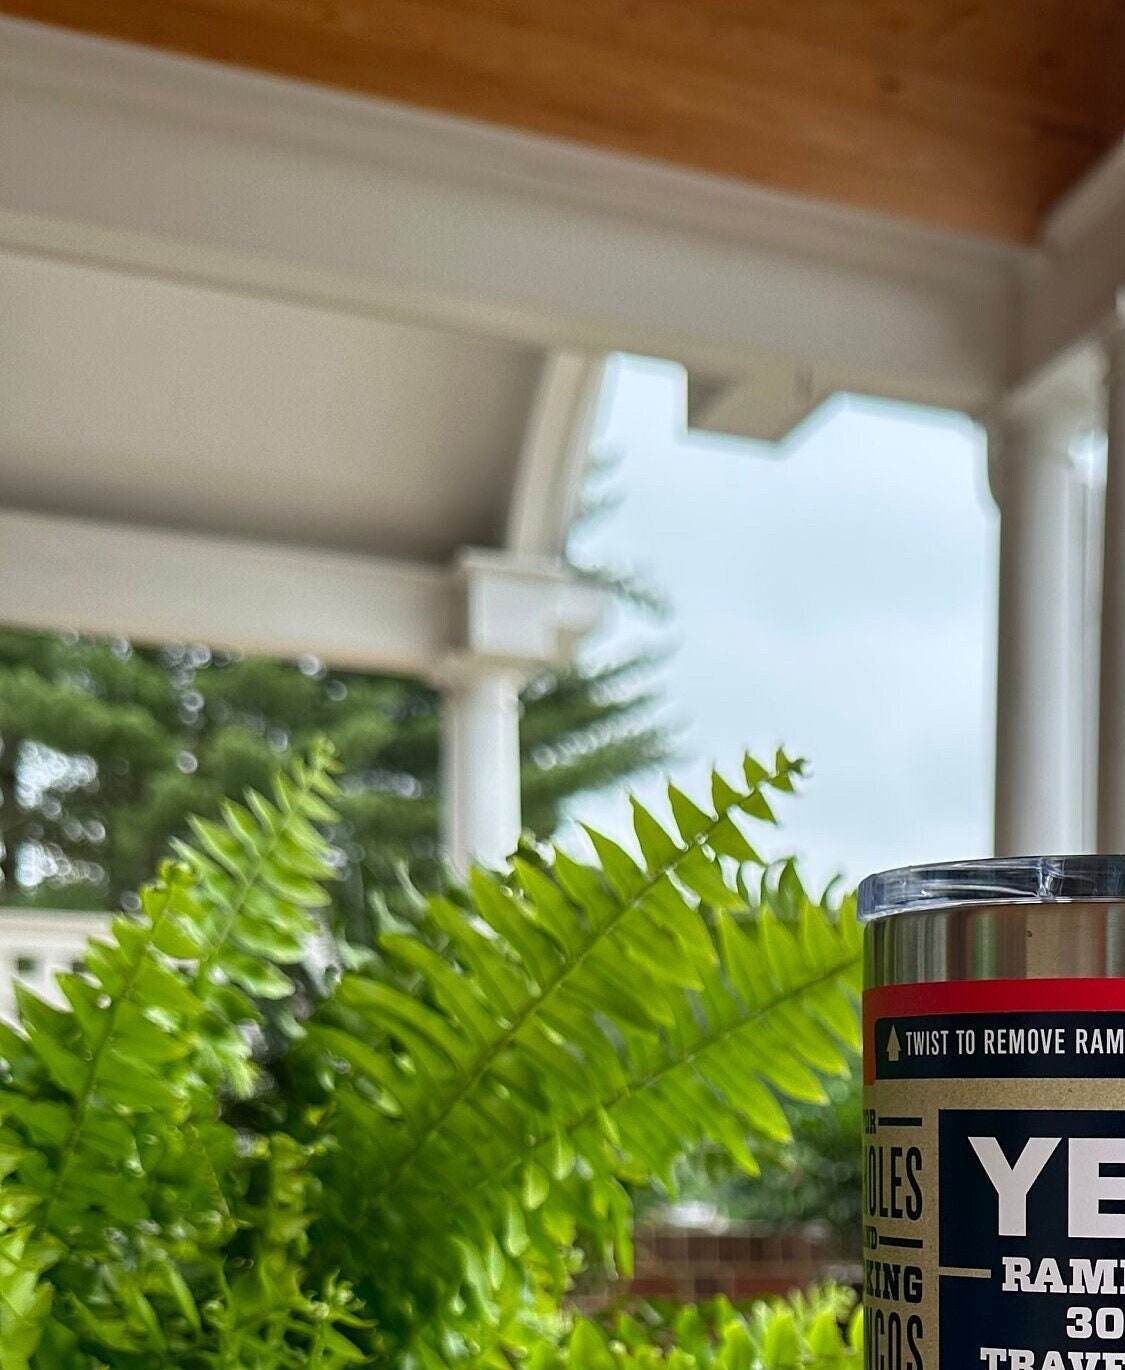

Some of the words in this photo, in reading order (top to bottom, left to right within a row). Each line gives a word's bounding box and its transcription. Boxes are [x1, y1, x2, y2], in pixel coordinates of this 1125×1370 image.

[906, 1030, 949, 1056] TWIST
[955, 1029, 976, 1055] TO
[984, 1028, 1066, 1055] REMOVE
[1066, 1306, 1125, 1340] 30
